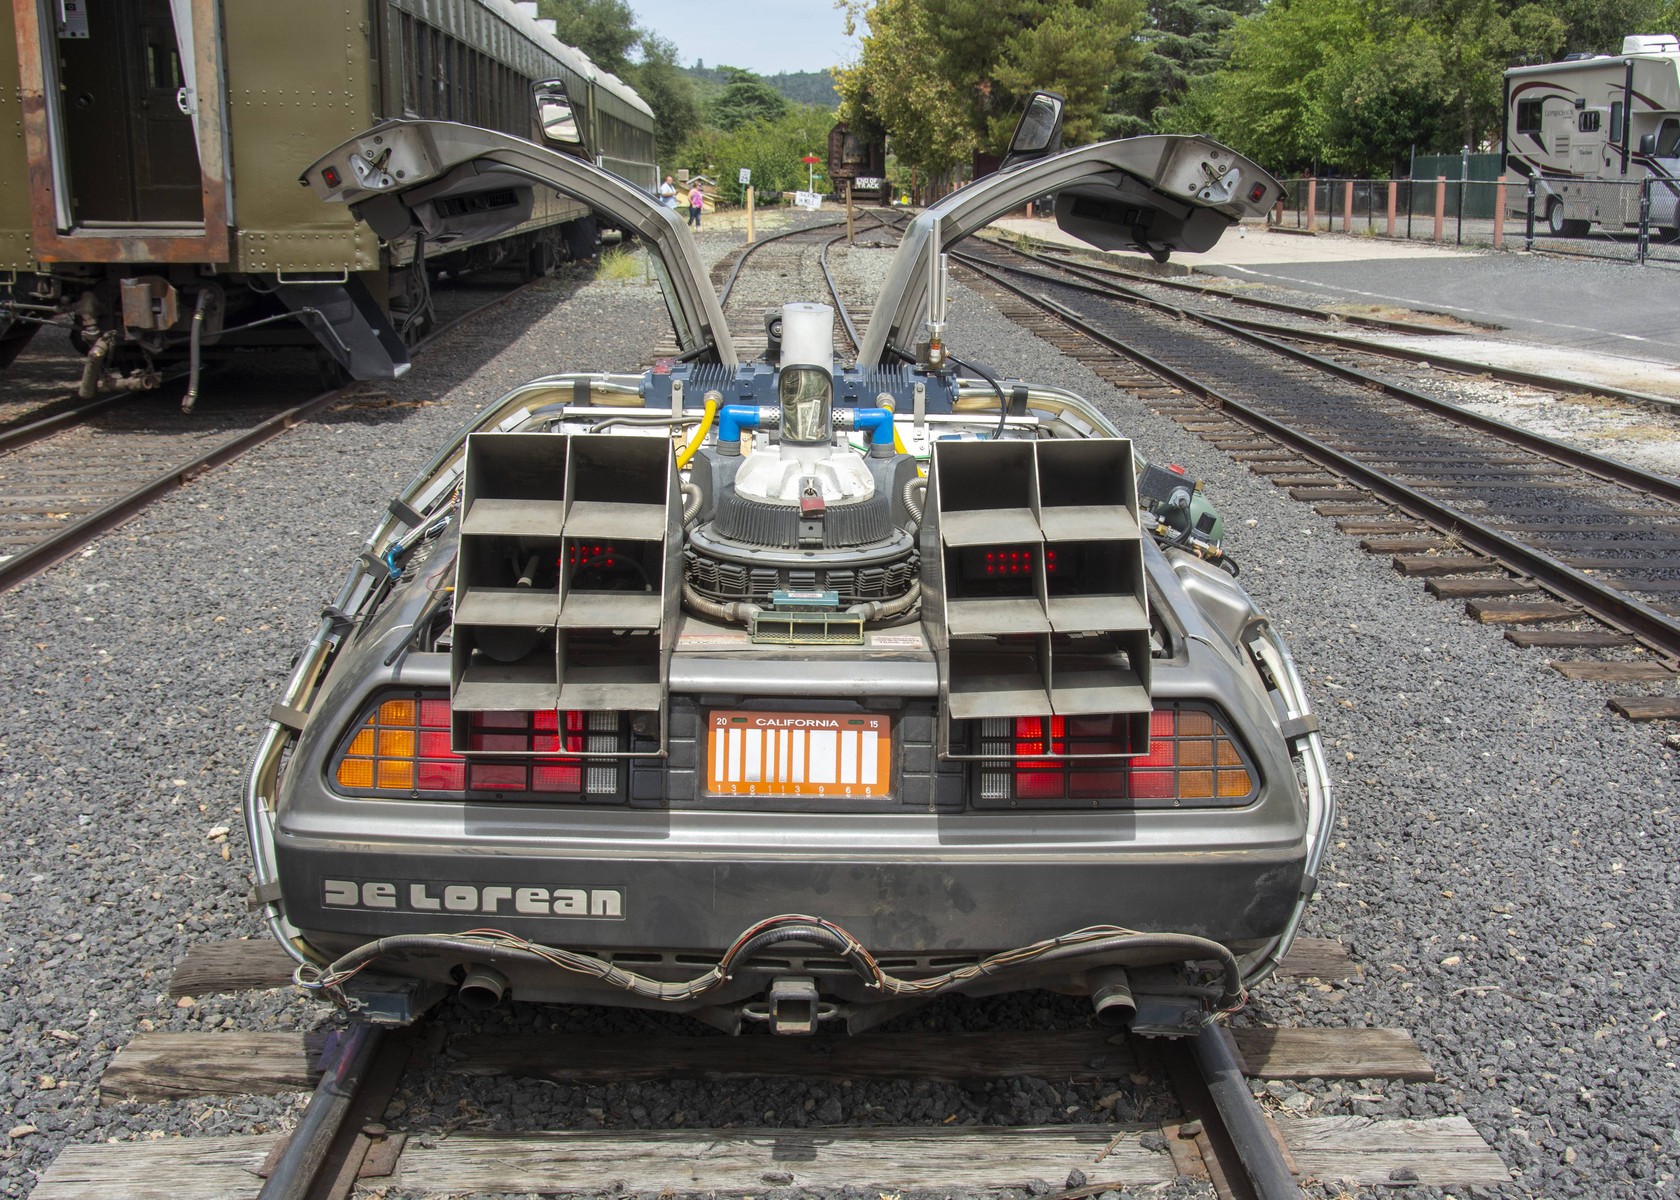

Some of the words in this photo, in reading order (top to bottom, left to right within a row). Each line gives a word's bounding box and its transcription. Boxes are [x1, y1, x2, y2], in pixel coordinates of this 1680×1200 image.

[716, 717, 727, 726] 20
[756, 718, 839, 727] CALIFORNIA
[870, 720, 878, 728] 15
